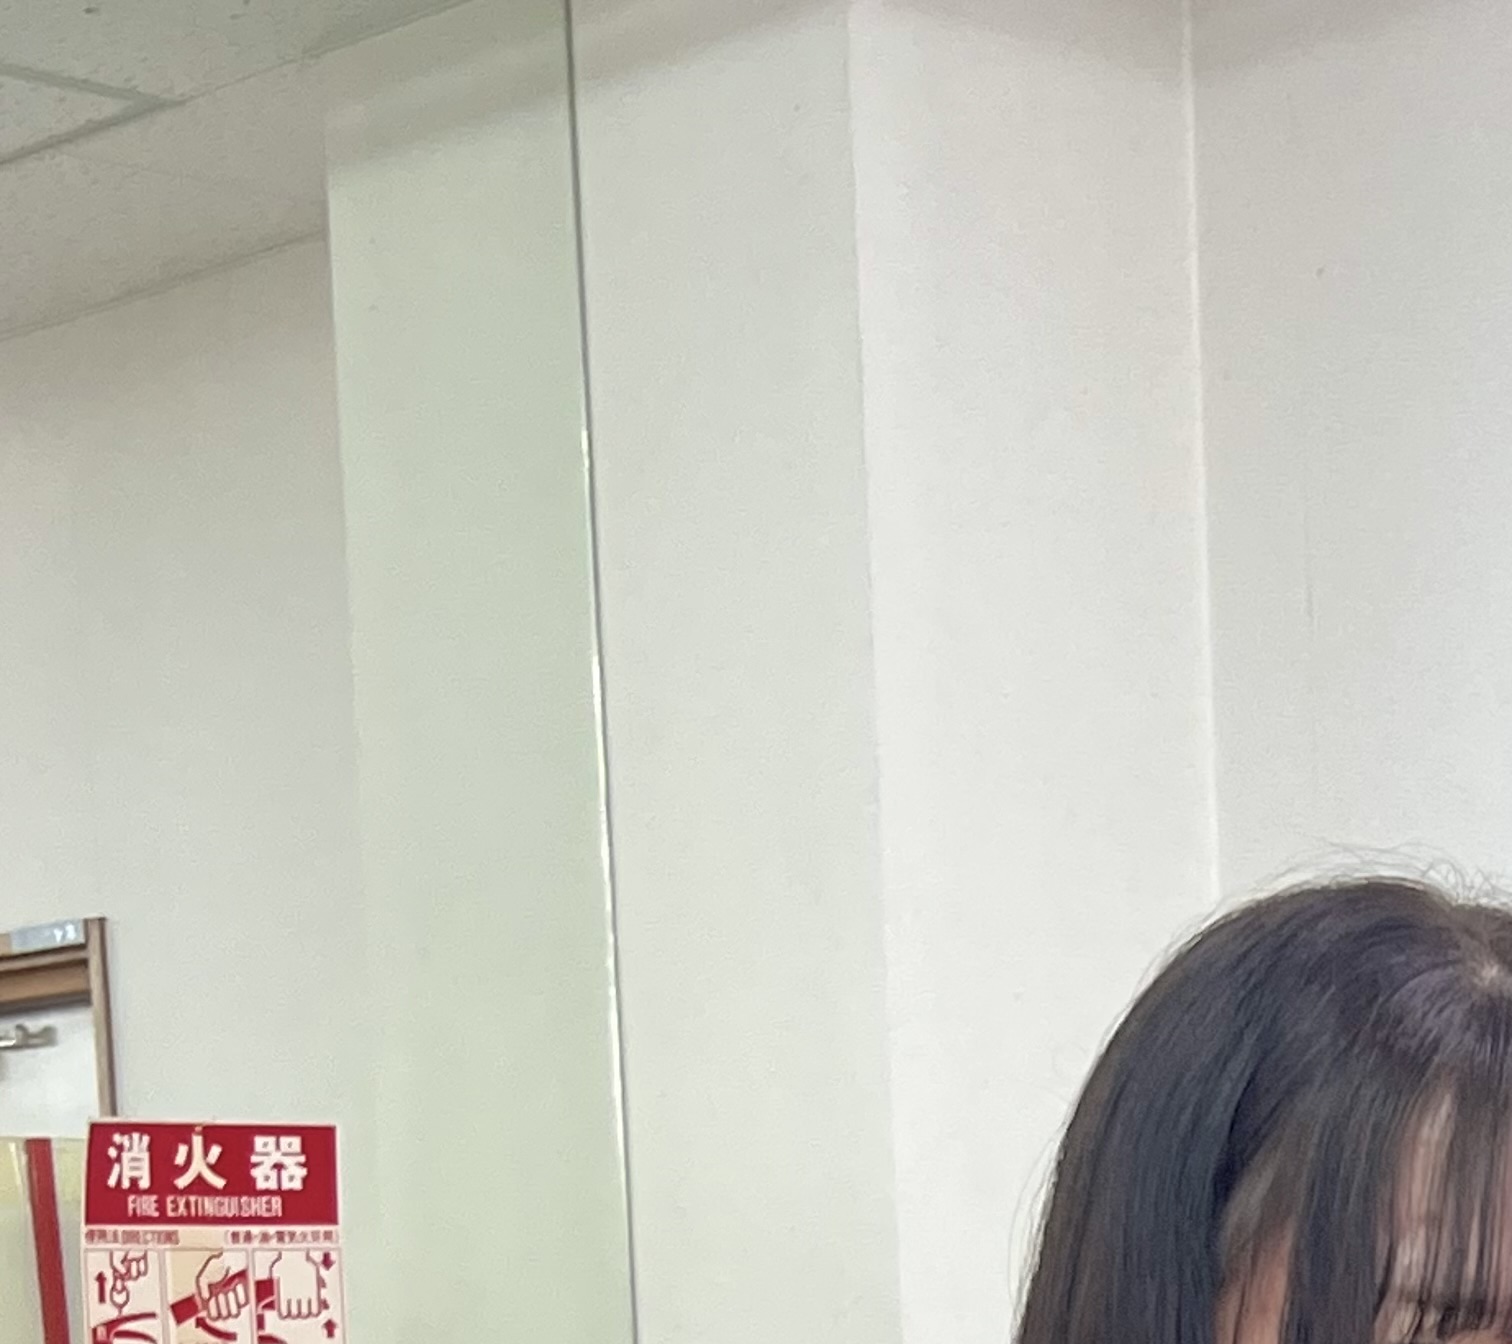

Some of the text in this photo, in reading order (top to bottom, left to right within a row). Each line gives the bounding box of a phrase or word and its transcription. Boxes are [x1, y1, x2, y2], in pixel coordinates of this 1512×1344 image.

[107, 1132, 308, 1190] 消火器
[128, 1195, 282, 1217] FIRE EXTINGUISHER
